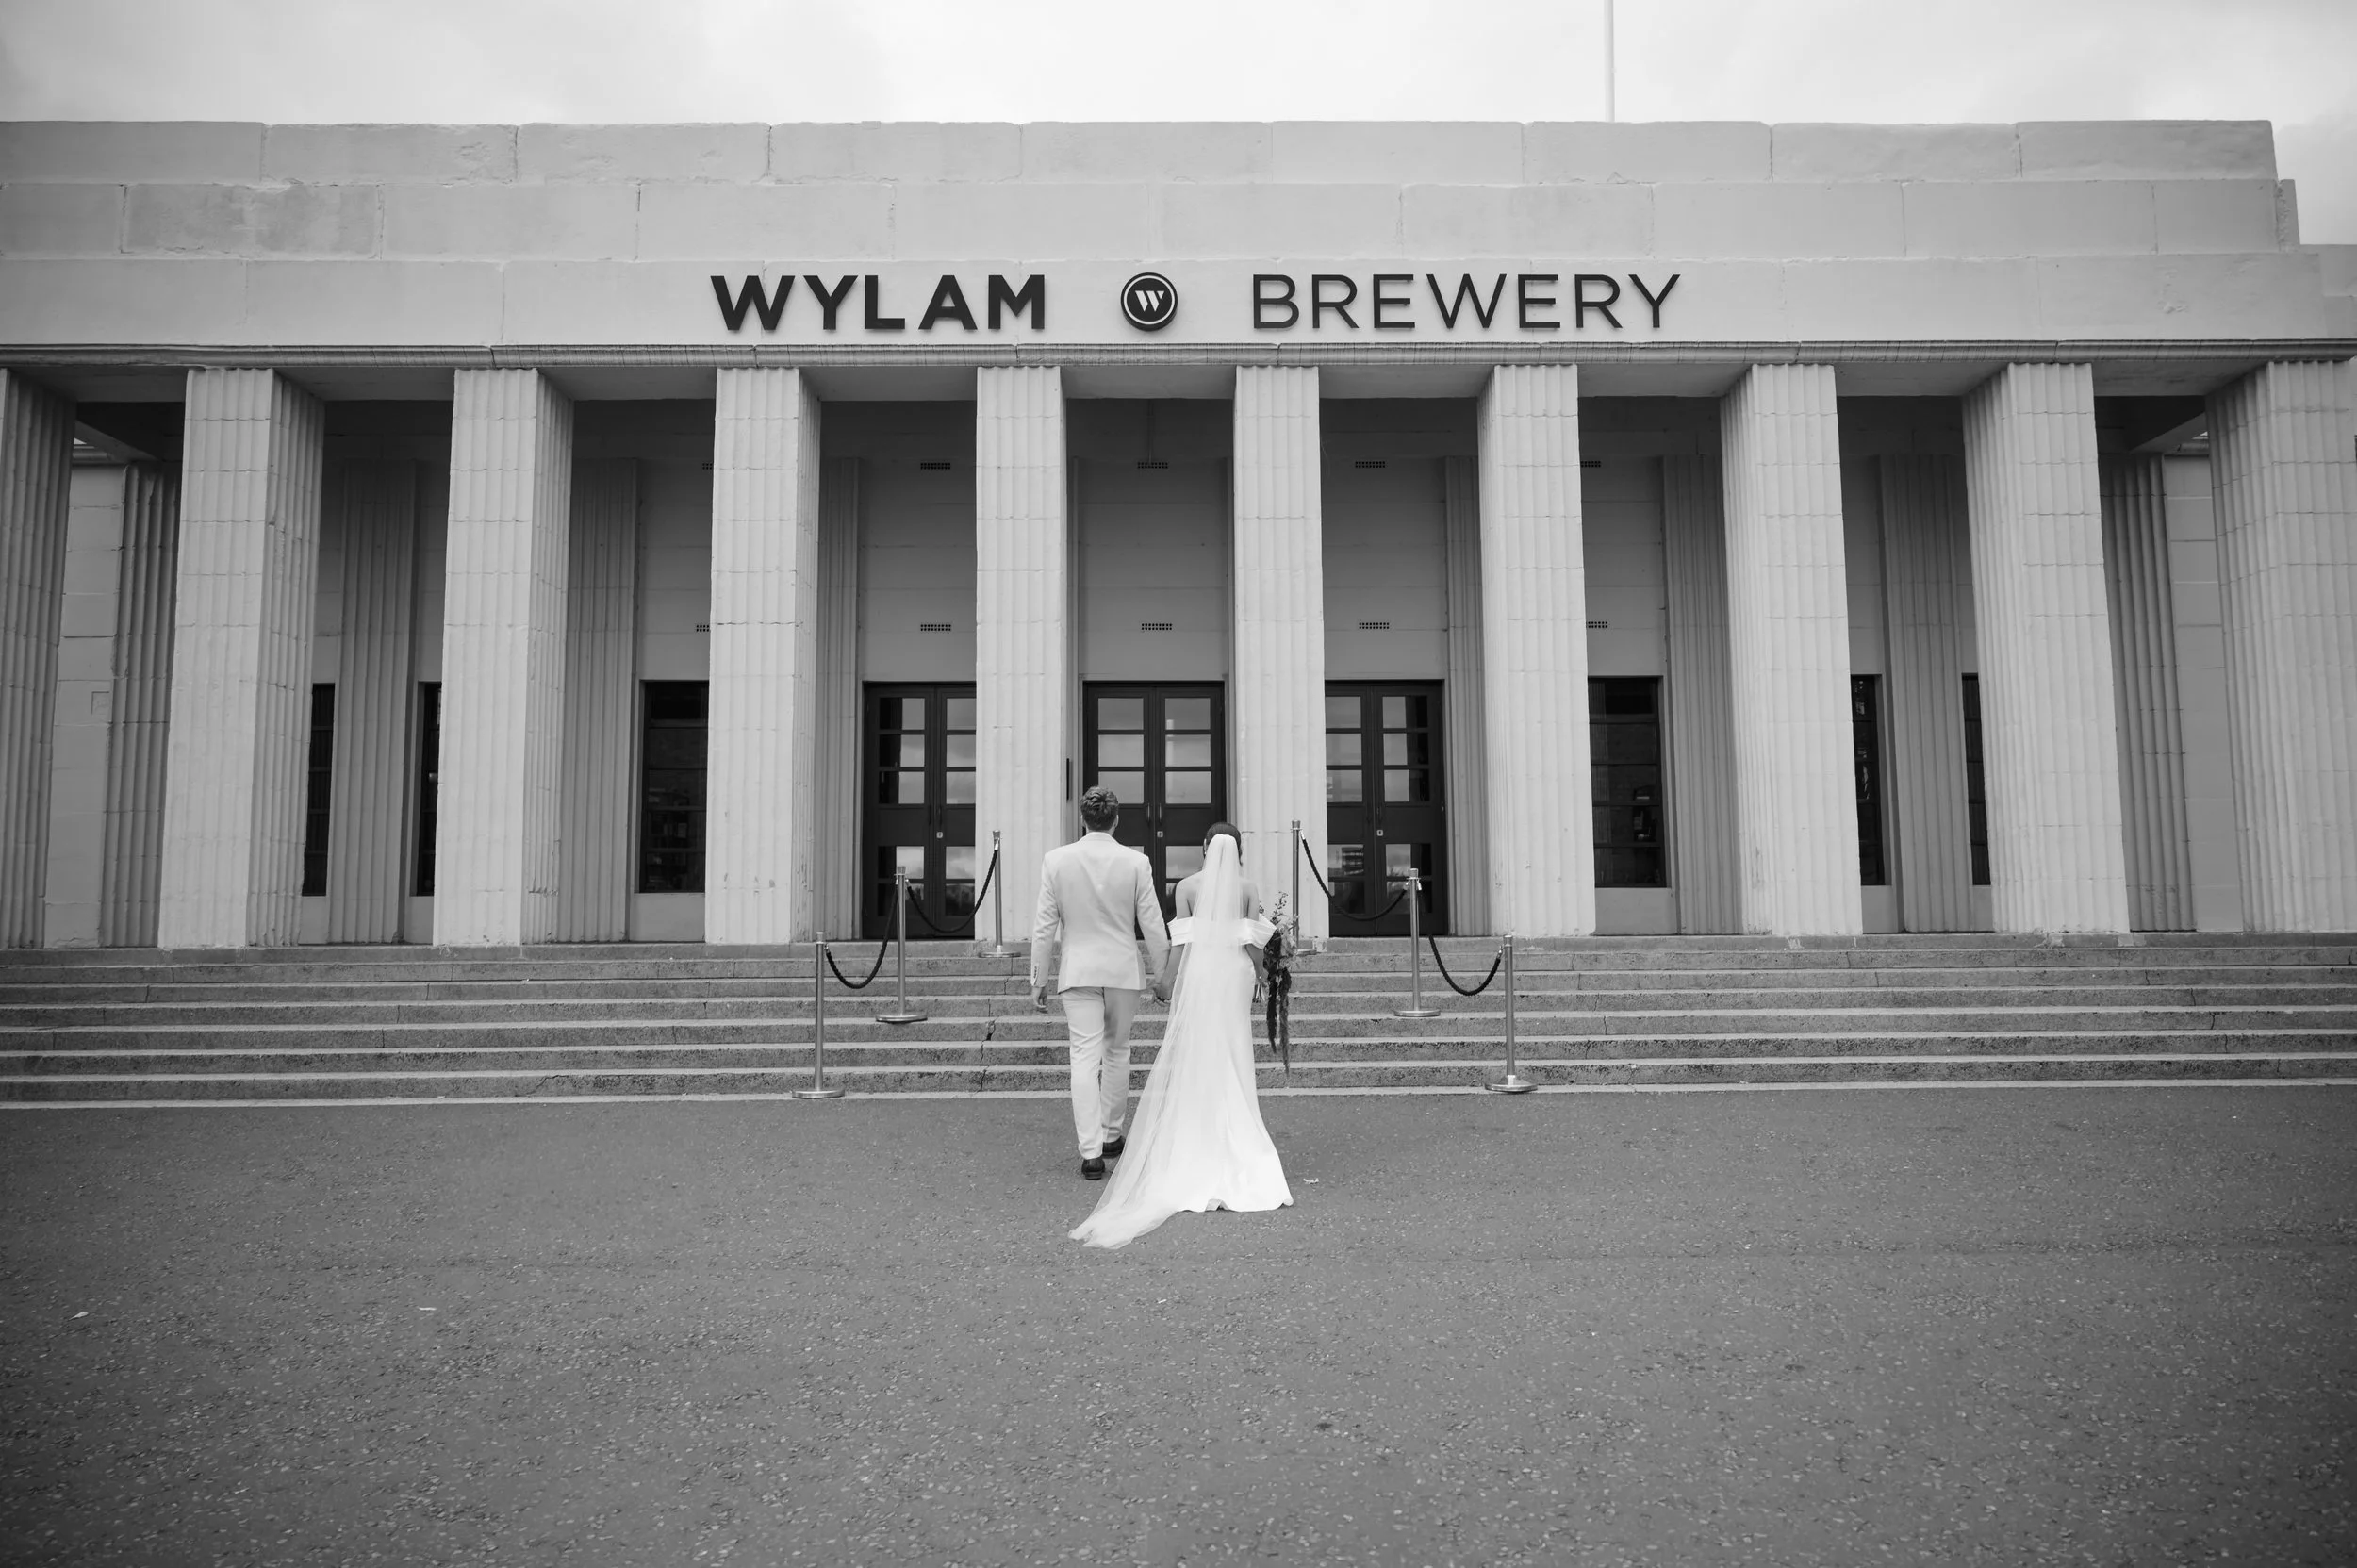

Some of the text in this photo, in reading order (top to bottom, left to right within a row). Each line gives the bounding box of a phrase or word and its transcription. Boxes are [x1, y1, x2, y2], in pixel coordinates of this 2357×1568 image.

[711, 273, 1680, 330] WYLAM W BREWERY
